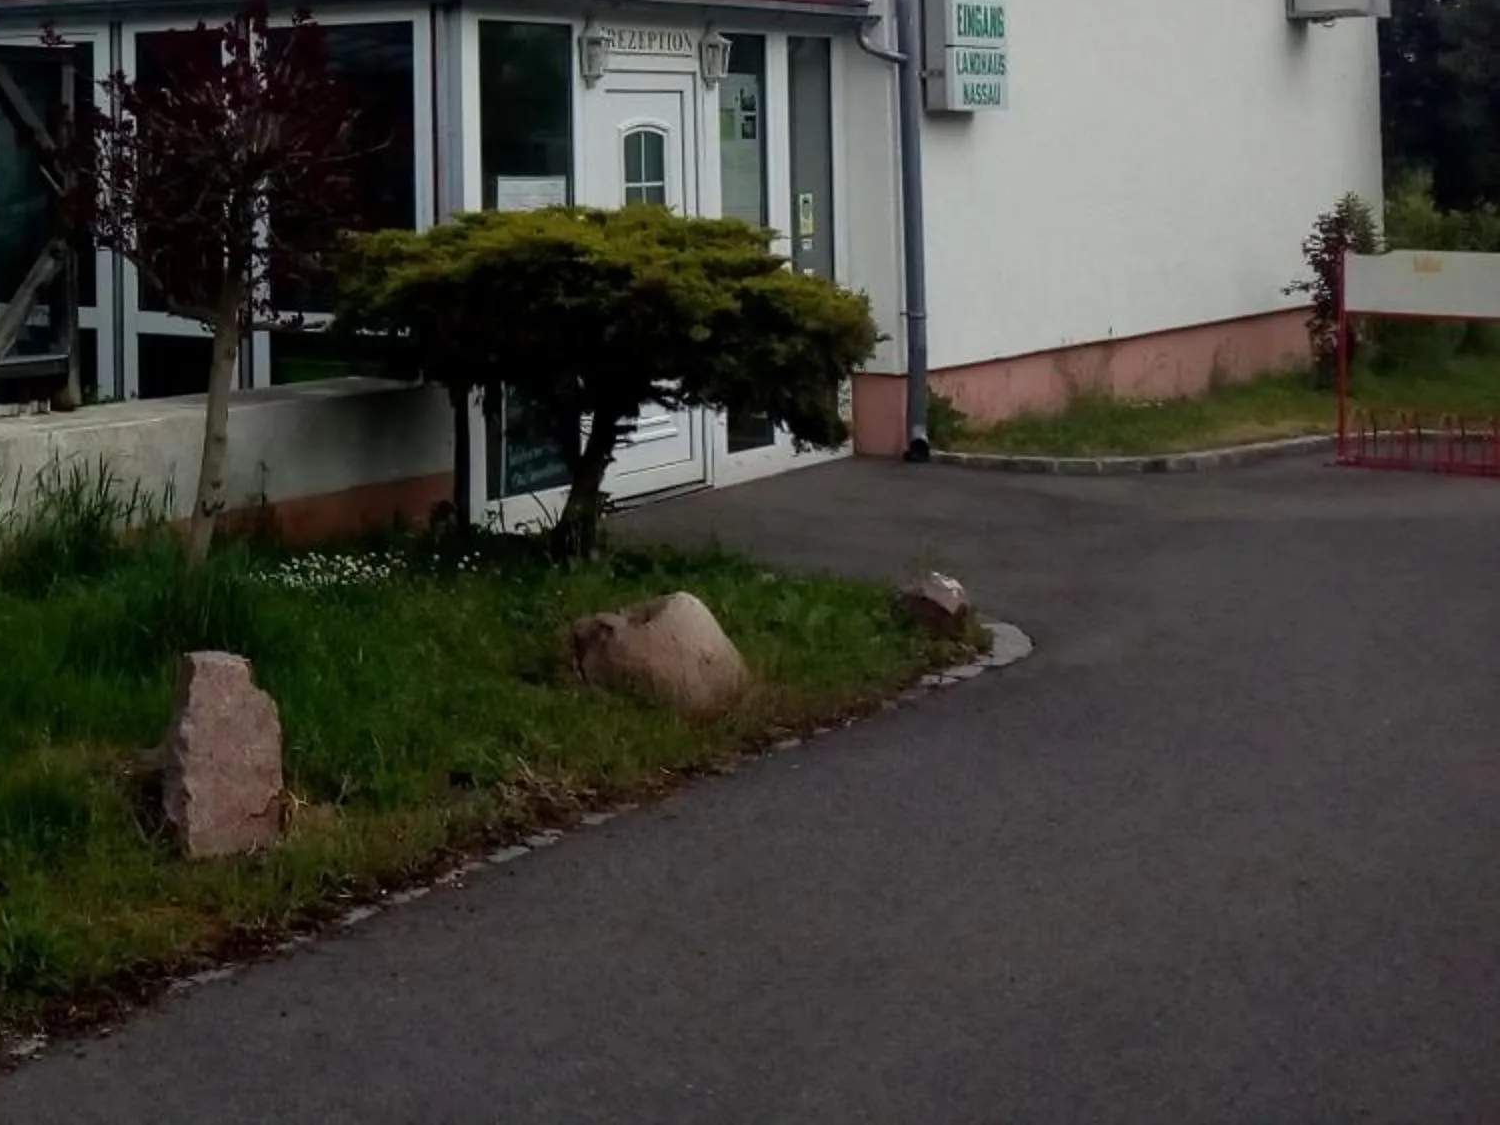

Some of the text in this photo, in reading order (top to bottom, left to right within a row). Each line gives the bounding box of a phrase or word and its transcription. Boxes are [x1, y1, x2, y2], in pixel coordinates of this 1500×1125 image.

[957, 3, 1005, 38] EINGANG
[606, 30, 694, 52] REZEPTION
[955, 51, 1007, 76] LANDHAUS
[963, 82, 1002, 106] NASSAU
